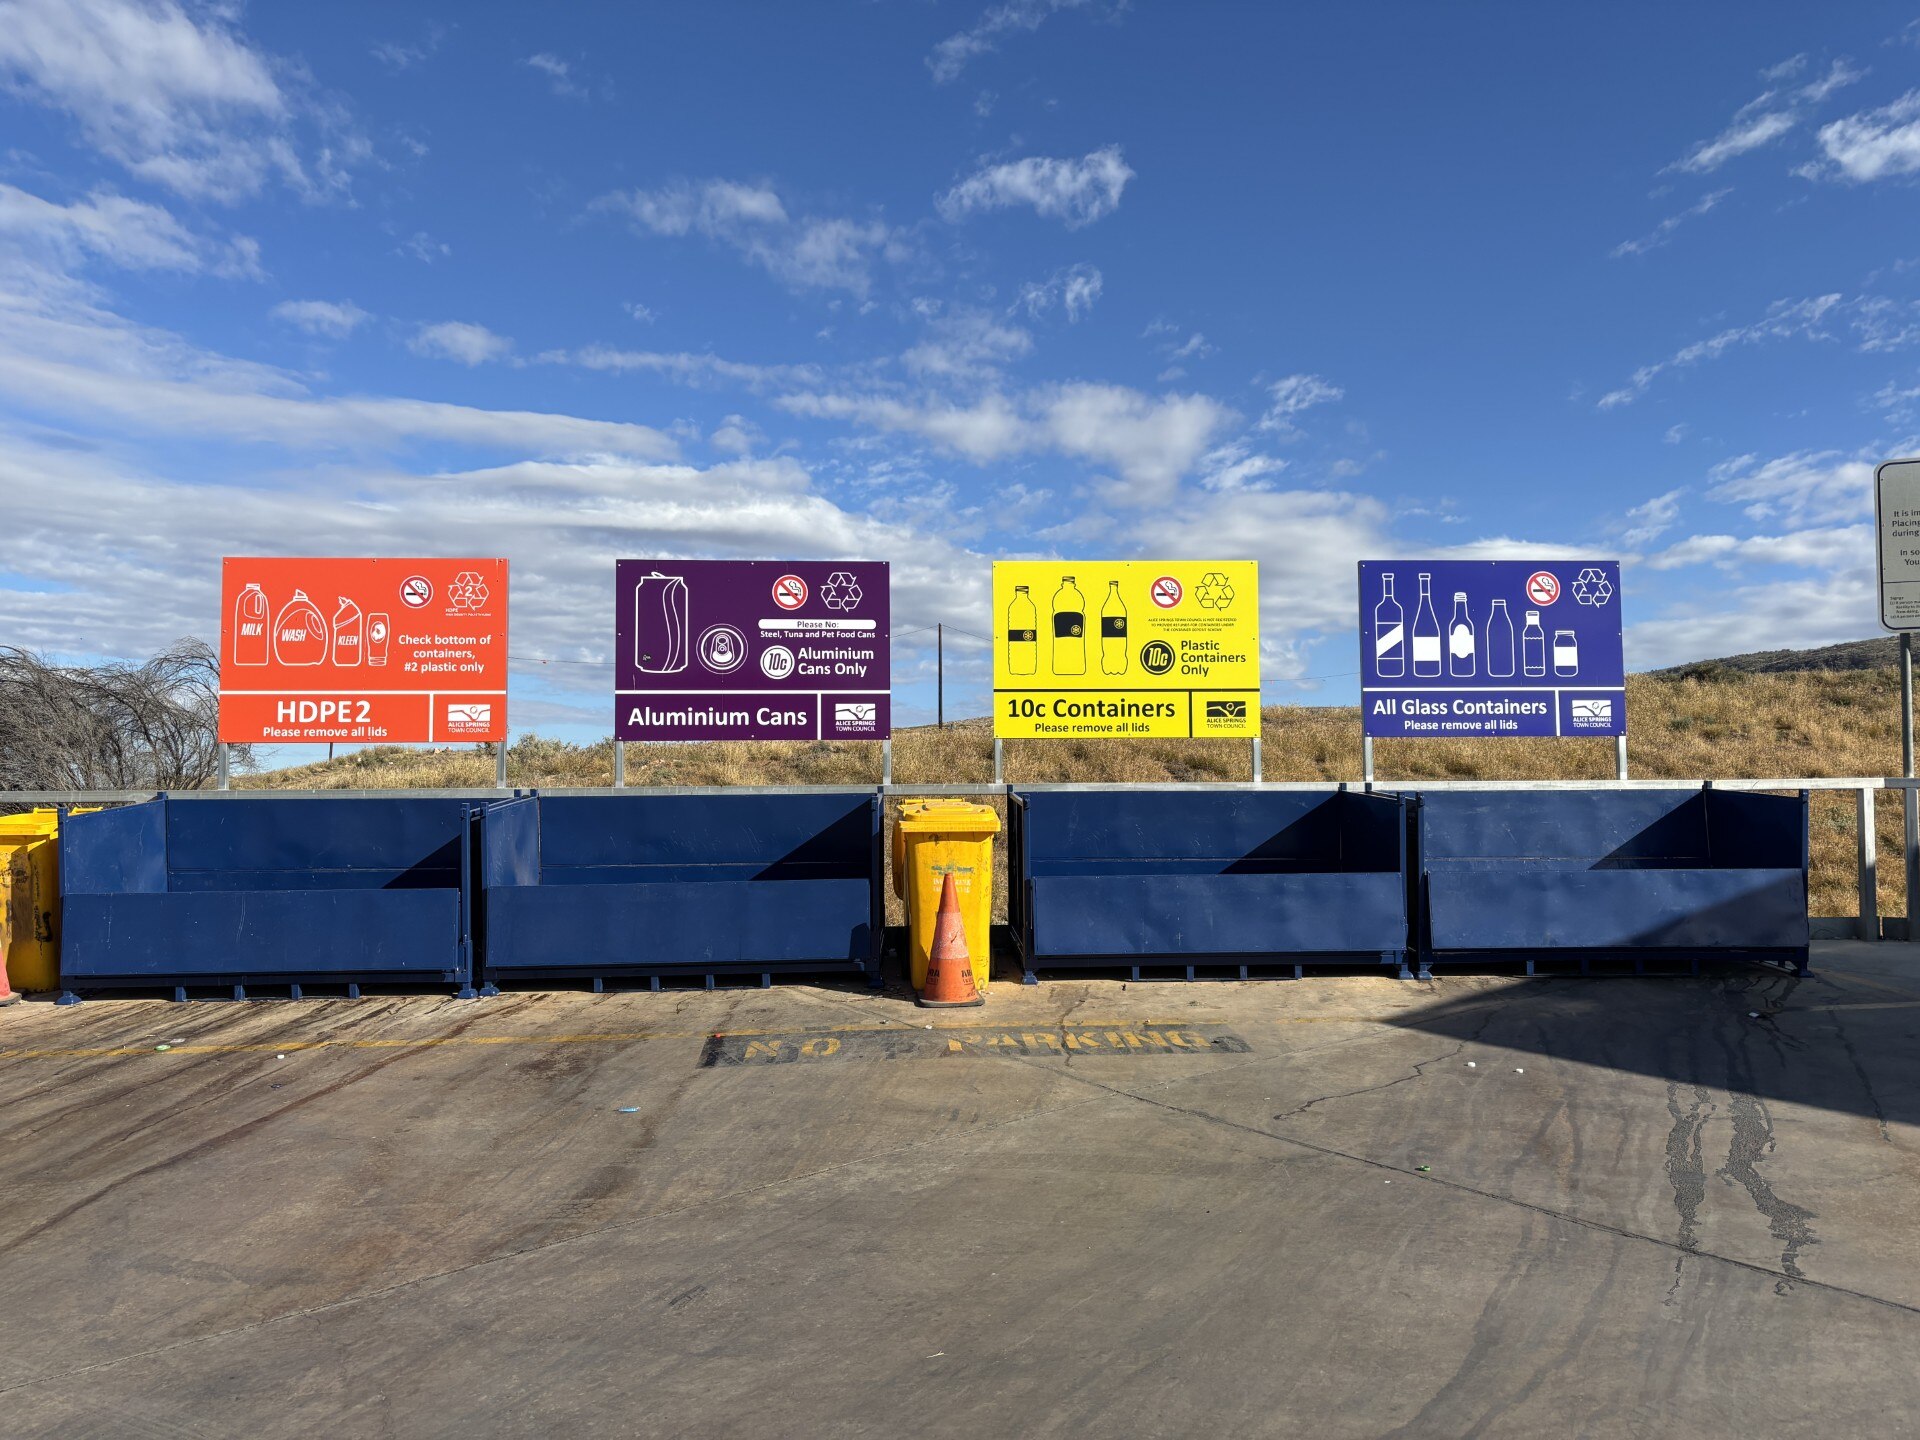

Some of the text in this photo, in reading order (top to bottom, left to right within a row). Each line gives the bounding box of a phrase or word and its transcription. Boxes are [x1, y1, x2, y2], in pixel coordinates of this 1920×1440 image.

[1902, 509, 1908, 517] is
[1892, 529, 1919, 537] during
[465, 586, 472, 596] 2
[241, 623, 263, 635] MILK
[825, 620, 839, 628] No:
[282, 629, 306, 641] WASH
[338, 636, 358, 645] KLEEN
[399, 635, 491, 644] Check bottom of
[1181, 640, 1219, 651] Plastic
[413, 649, 475, 659] containers,
[798, 647, 874, 659] Aluminium
[1148, 648, 1168, 666] 10c
[1181, 652, 1246, 663] Containers
[404, 662, 484, 673] #2 plastic only
[768, 653, 786, 671] 10c
[798, 663, 867, 677] Cans Only
[1181, 664, 1209, 677] Only
[278, 700, 370, 722] HDPE2
[1009, 698, 1175, 717] 10c Containers
[1373, 699, 1547, 714] All Glass Containers
[628, 707, 807, 725] Aluminium Cans
[1035, 723, 1149, 732] Please remove all lids
[1405, 720, 1518, 730] Please remove all lids
[263, 727, 300, 737] Please
[351, 726, 364, 736] all
[368, 726, 387, 737] lids
[744, 1030, 1212, 1060] NO PARKING
